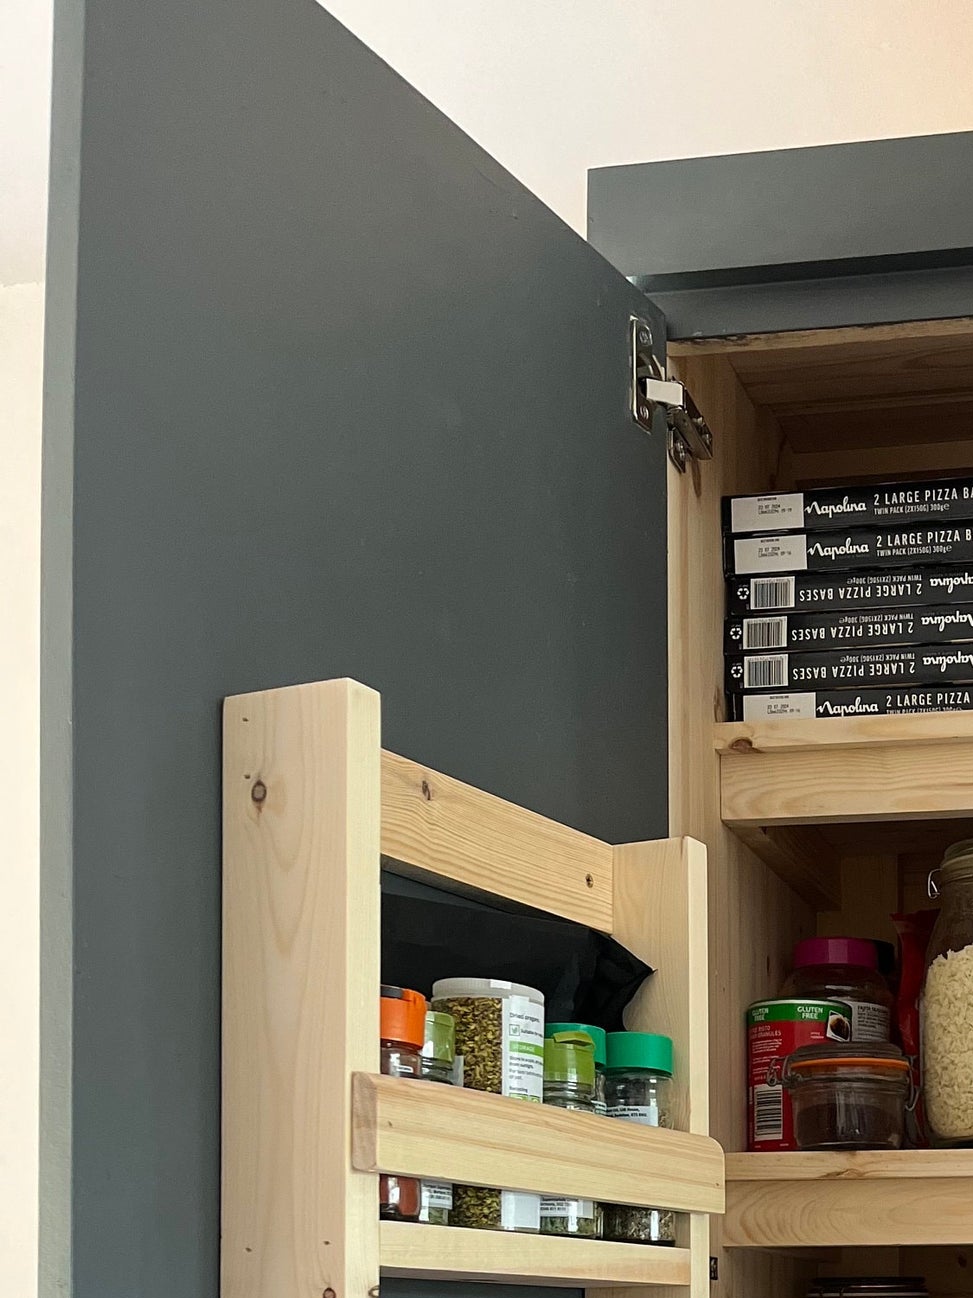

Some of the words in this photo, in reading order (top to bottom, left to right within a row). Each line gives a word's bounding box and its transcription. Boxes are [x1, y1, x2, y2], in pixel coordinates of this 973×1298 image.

[874, 493, 880, 505] 2
[885, 490, 920, 505] LARGE
[925, 488, 958, 501] PIZZA
[804, 496, 867, 518] Napolina
[876, 535, 882, 547] 2
[887, 532, 922, 547] LARGE
[927, 530, 961, 543] PIZZA
[807, 537, 869, 560] Napolina
[800, 588, 834, 602] BASES
[838, 586, 871, 599] PIZZA
[876, 584, 911, 597] LARGE
[916, 584, 922, 595] 2
[792, 628, 826, 640] BASES
[830, 625, 863, 638] PIZZA
[868, 622, 903, 636] LARGE
[908, 622, 914, 634] 2
[792, 667, 826, 680] BASES
[832, 664, 864, 678] PIZZA
[869, 662, 904, 676] LARGE
[909, 662, 915, 674] 2
[886, 696, 892, 708] 2
[897, 694, 932, 707] LARGE
[937, 692, 971, 705] PIZZA
[816, 697, 878, 717] Napolina
[797, 1006, 823, 1014] GLUTEN
[802, 1012, 819, 1020] FREE
